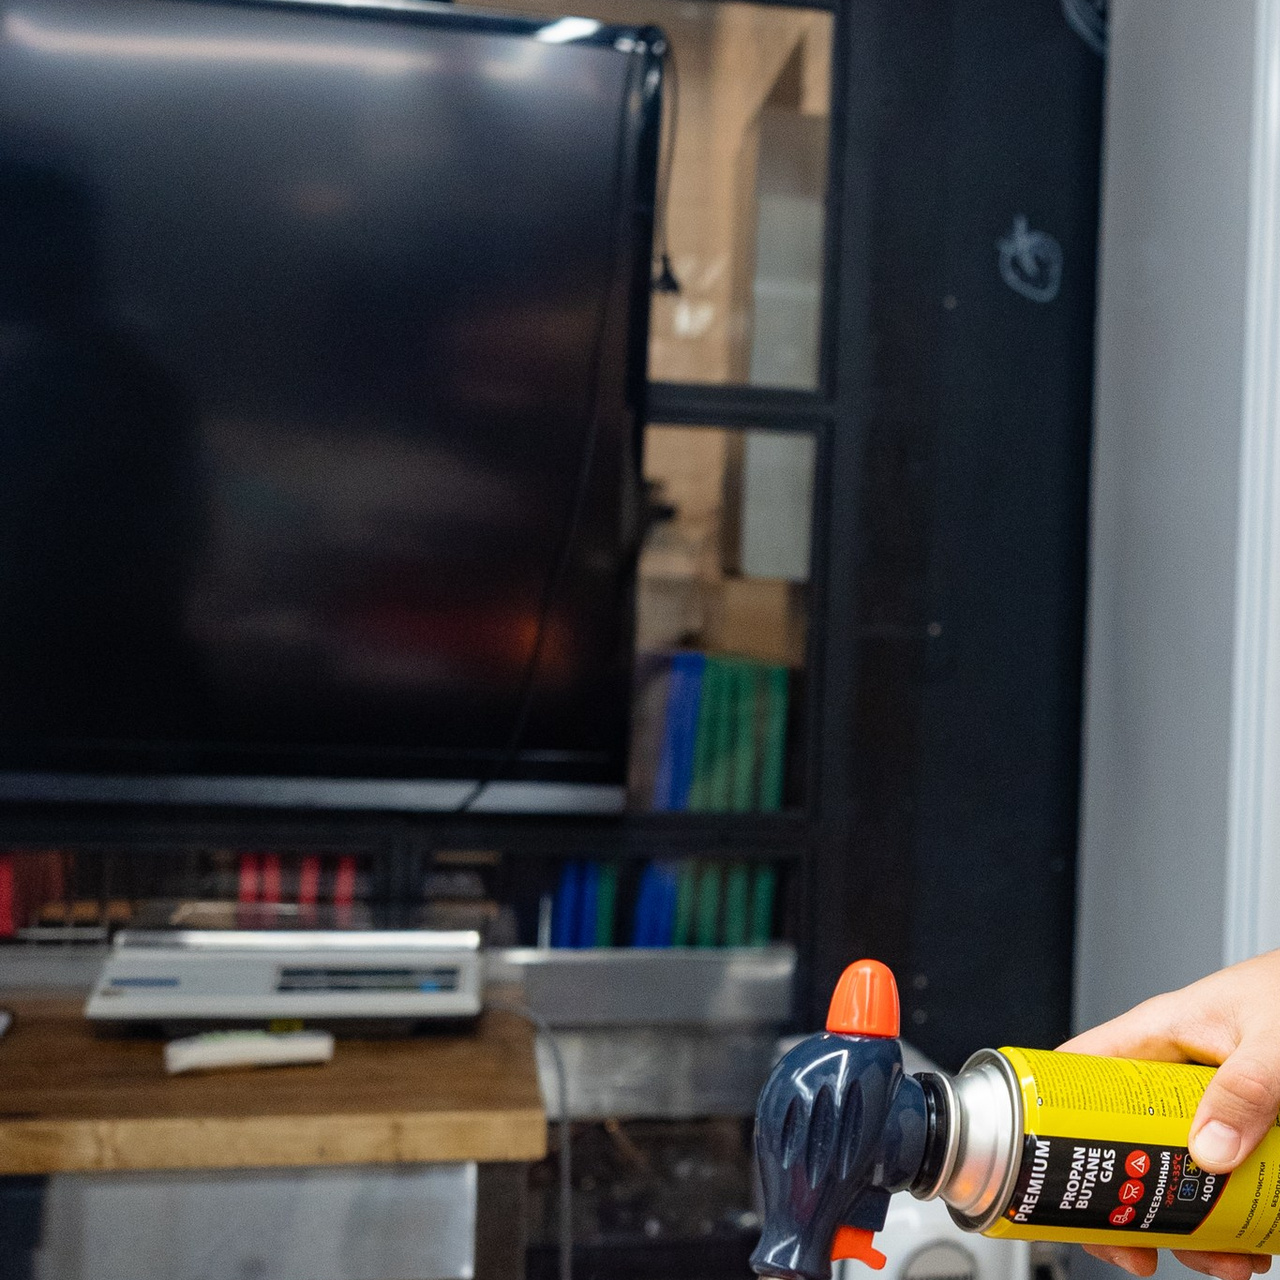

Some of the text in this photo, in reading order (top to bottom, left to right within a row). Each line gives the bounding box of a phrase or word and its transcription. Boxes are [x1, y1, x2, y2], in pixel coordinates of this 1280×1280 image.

[1014, 1140, 1051, 1222] PREMIUM
[1059, 1146, 1086, 1209] PROPAN
[1075, 1147, 1101, 1209] BUTANE
[1100, 1149, 1116, 1183] GAS
[1140, 1151, 1171, 1229] ВСЕСЕЗОННЫЙ
[1243, 1198, 1259, 1231] ВЫСОКОЙ
[1254, 1161, 1266, 1197] ОЧИСТКИ
